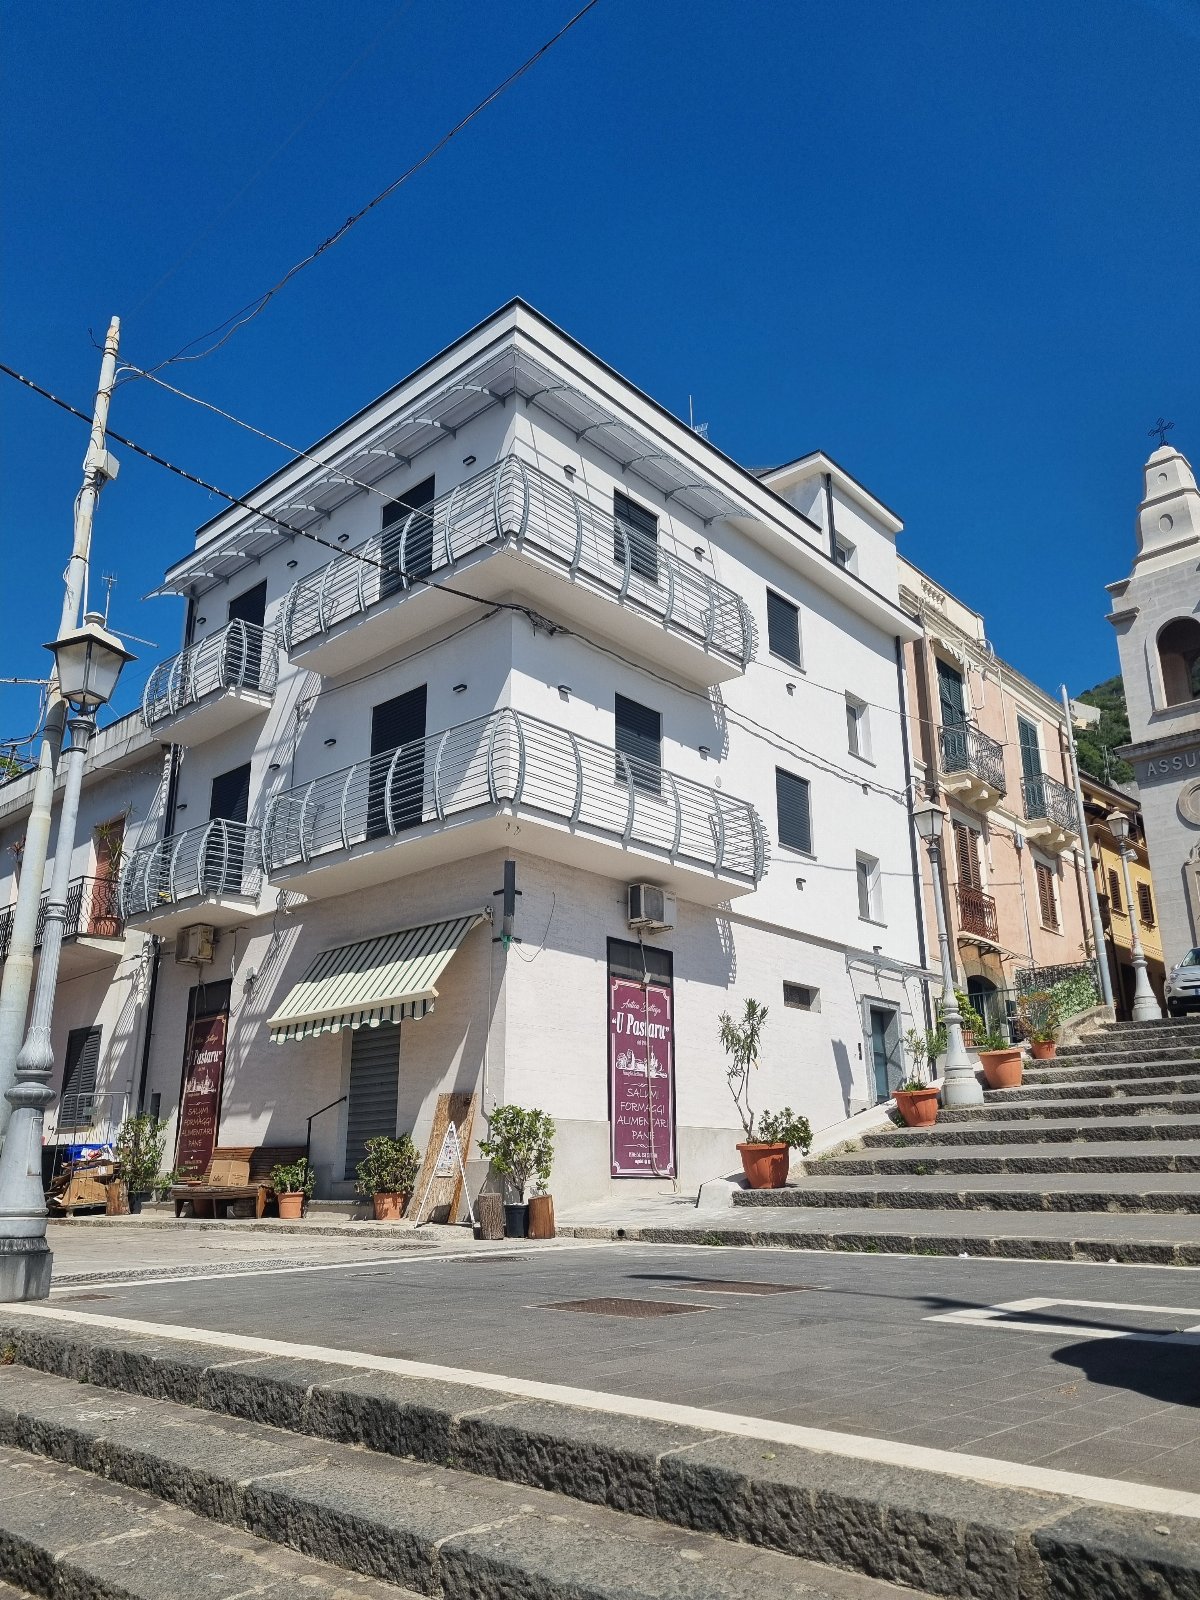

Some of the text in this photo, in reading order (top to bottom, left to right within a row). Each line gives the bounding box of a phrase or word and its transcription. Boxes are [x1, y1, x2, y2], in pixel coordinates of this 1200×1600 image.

[1147, 751, 1200, 777] ASSU
[620, 1101, 665, 1115] FORMAGGI
[631, 1130, 655, 1140] PANE
